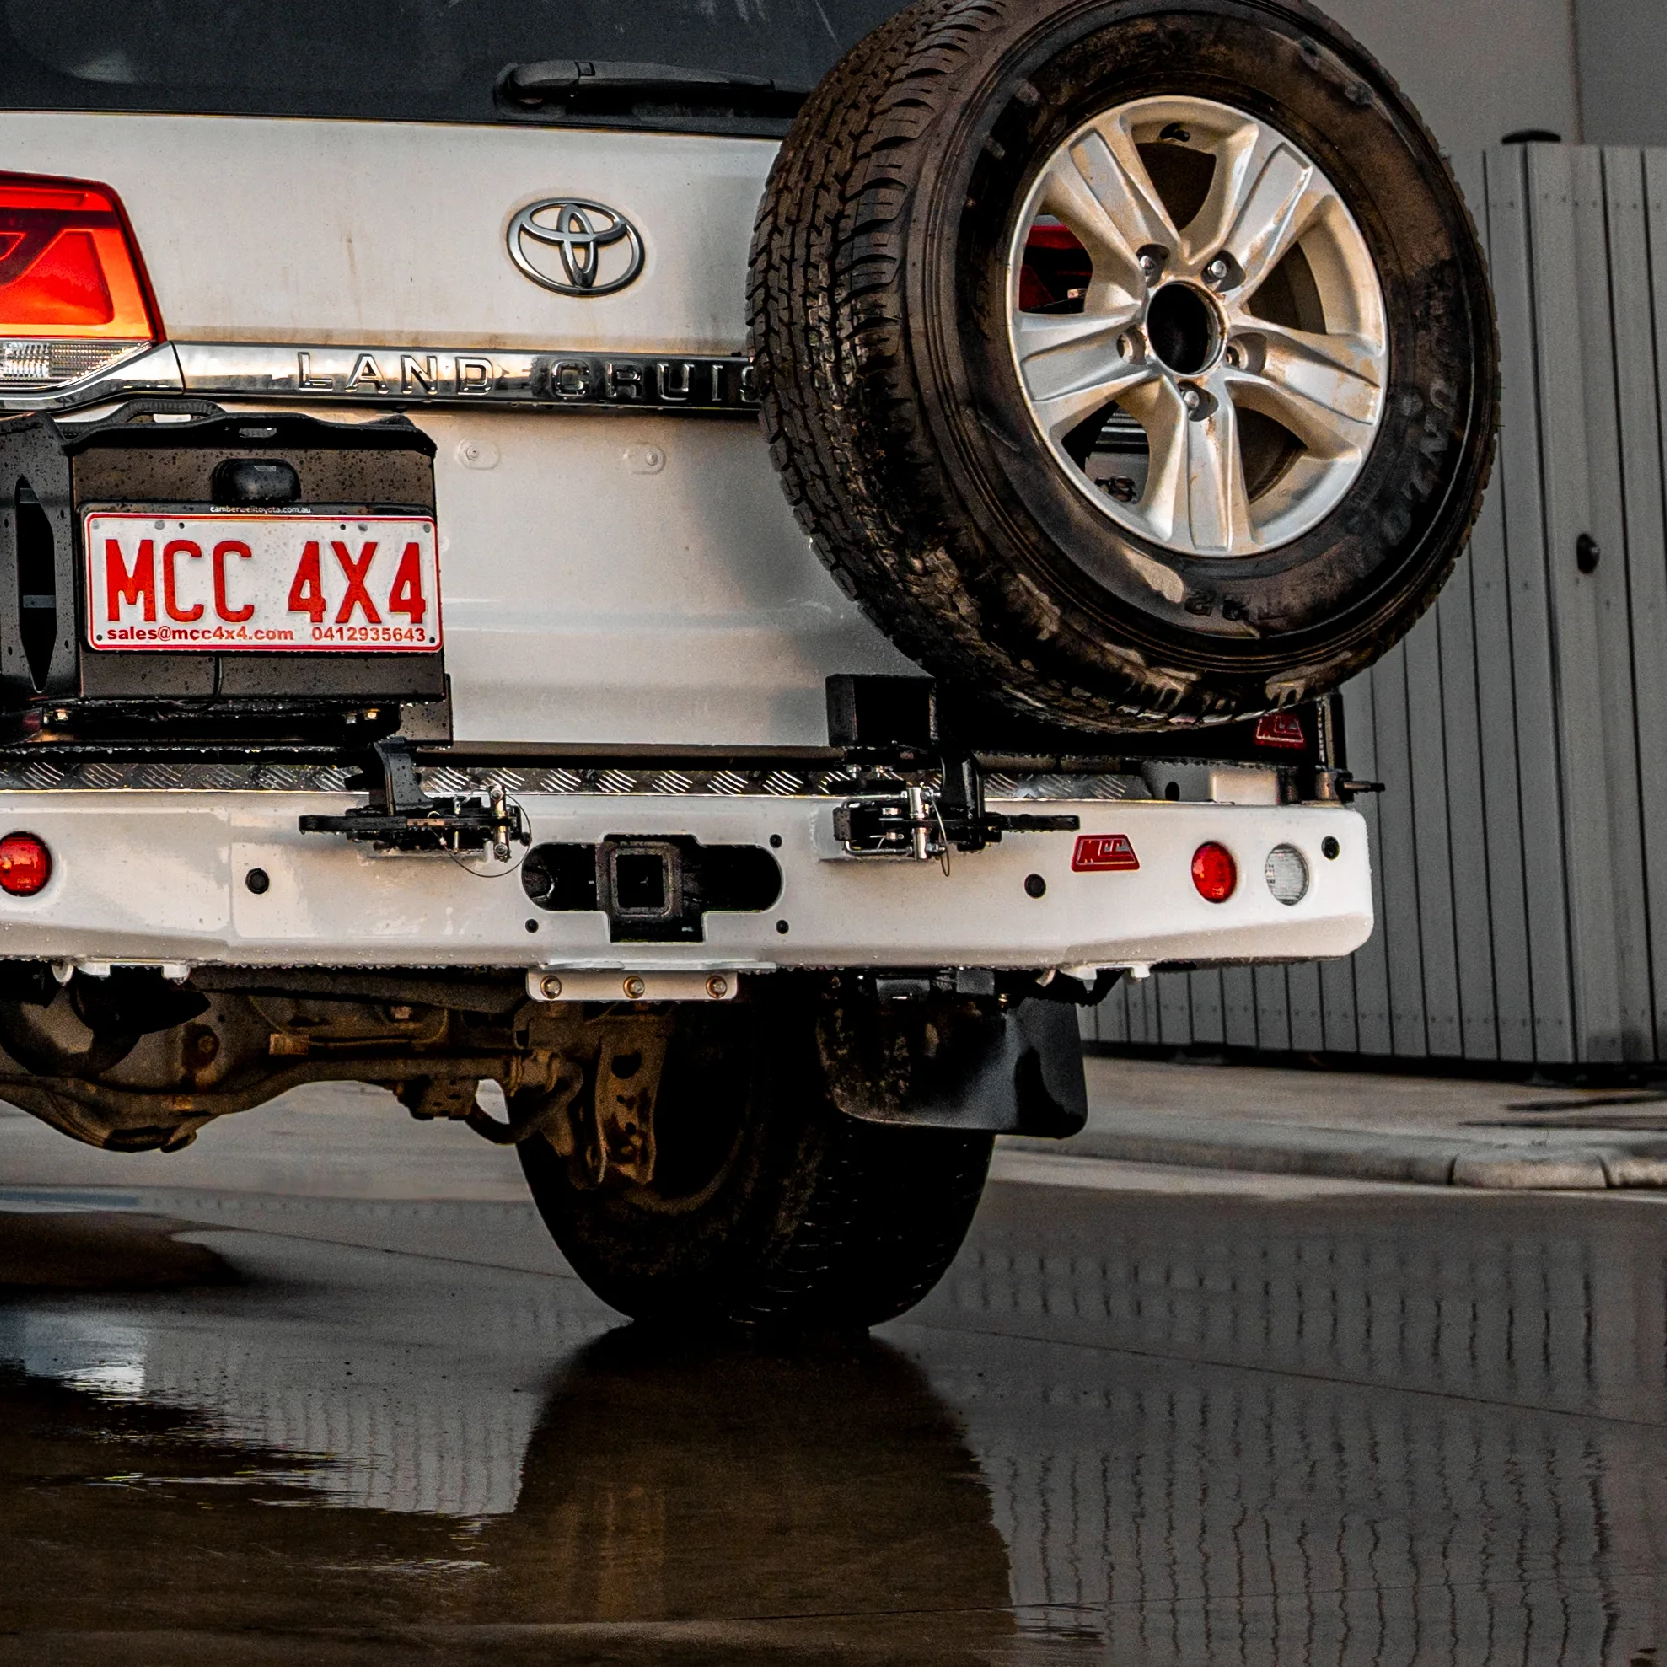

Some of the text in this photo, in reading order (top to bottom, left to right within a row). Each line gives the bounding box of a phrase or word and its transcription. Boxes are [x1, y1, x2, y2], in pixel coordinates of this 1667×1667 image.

[297, 351, 495, 396] LAND
[105, 538, 427, 625] MCC 4X4
[106, 626, 426, 643] sales@mcc4x4.com 0412935643
[1078, 839, 1134, 863] MCC
